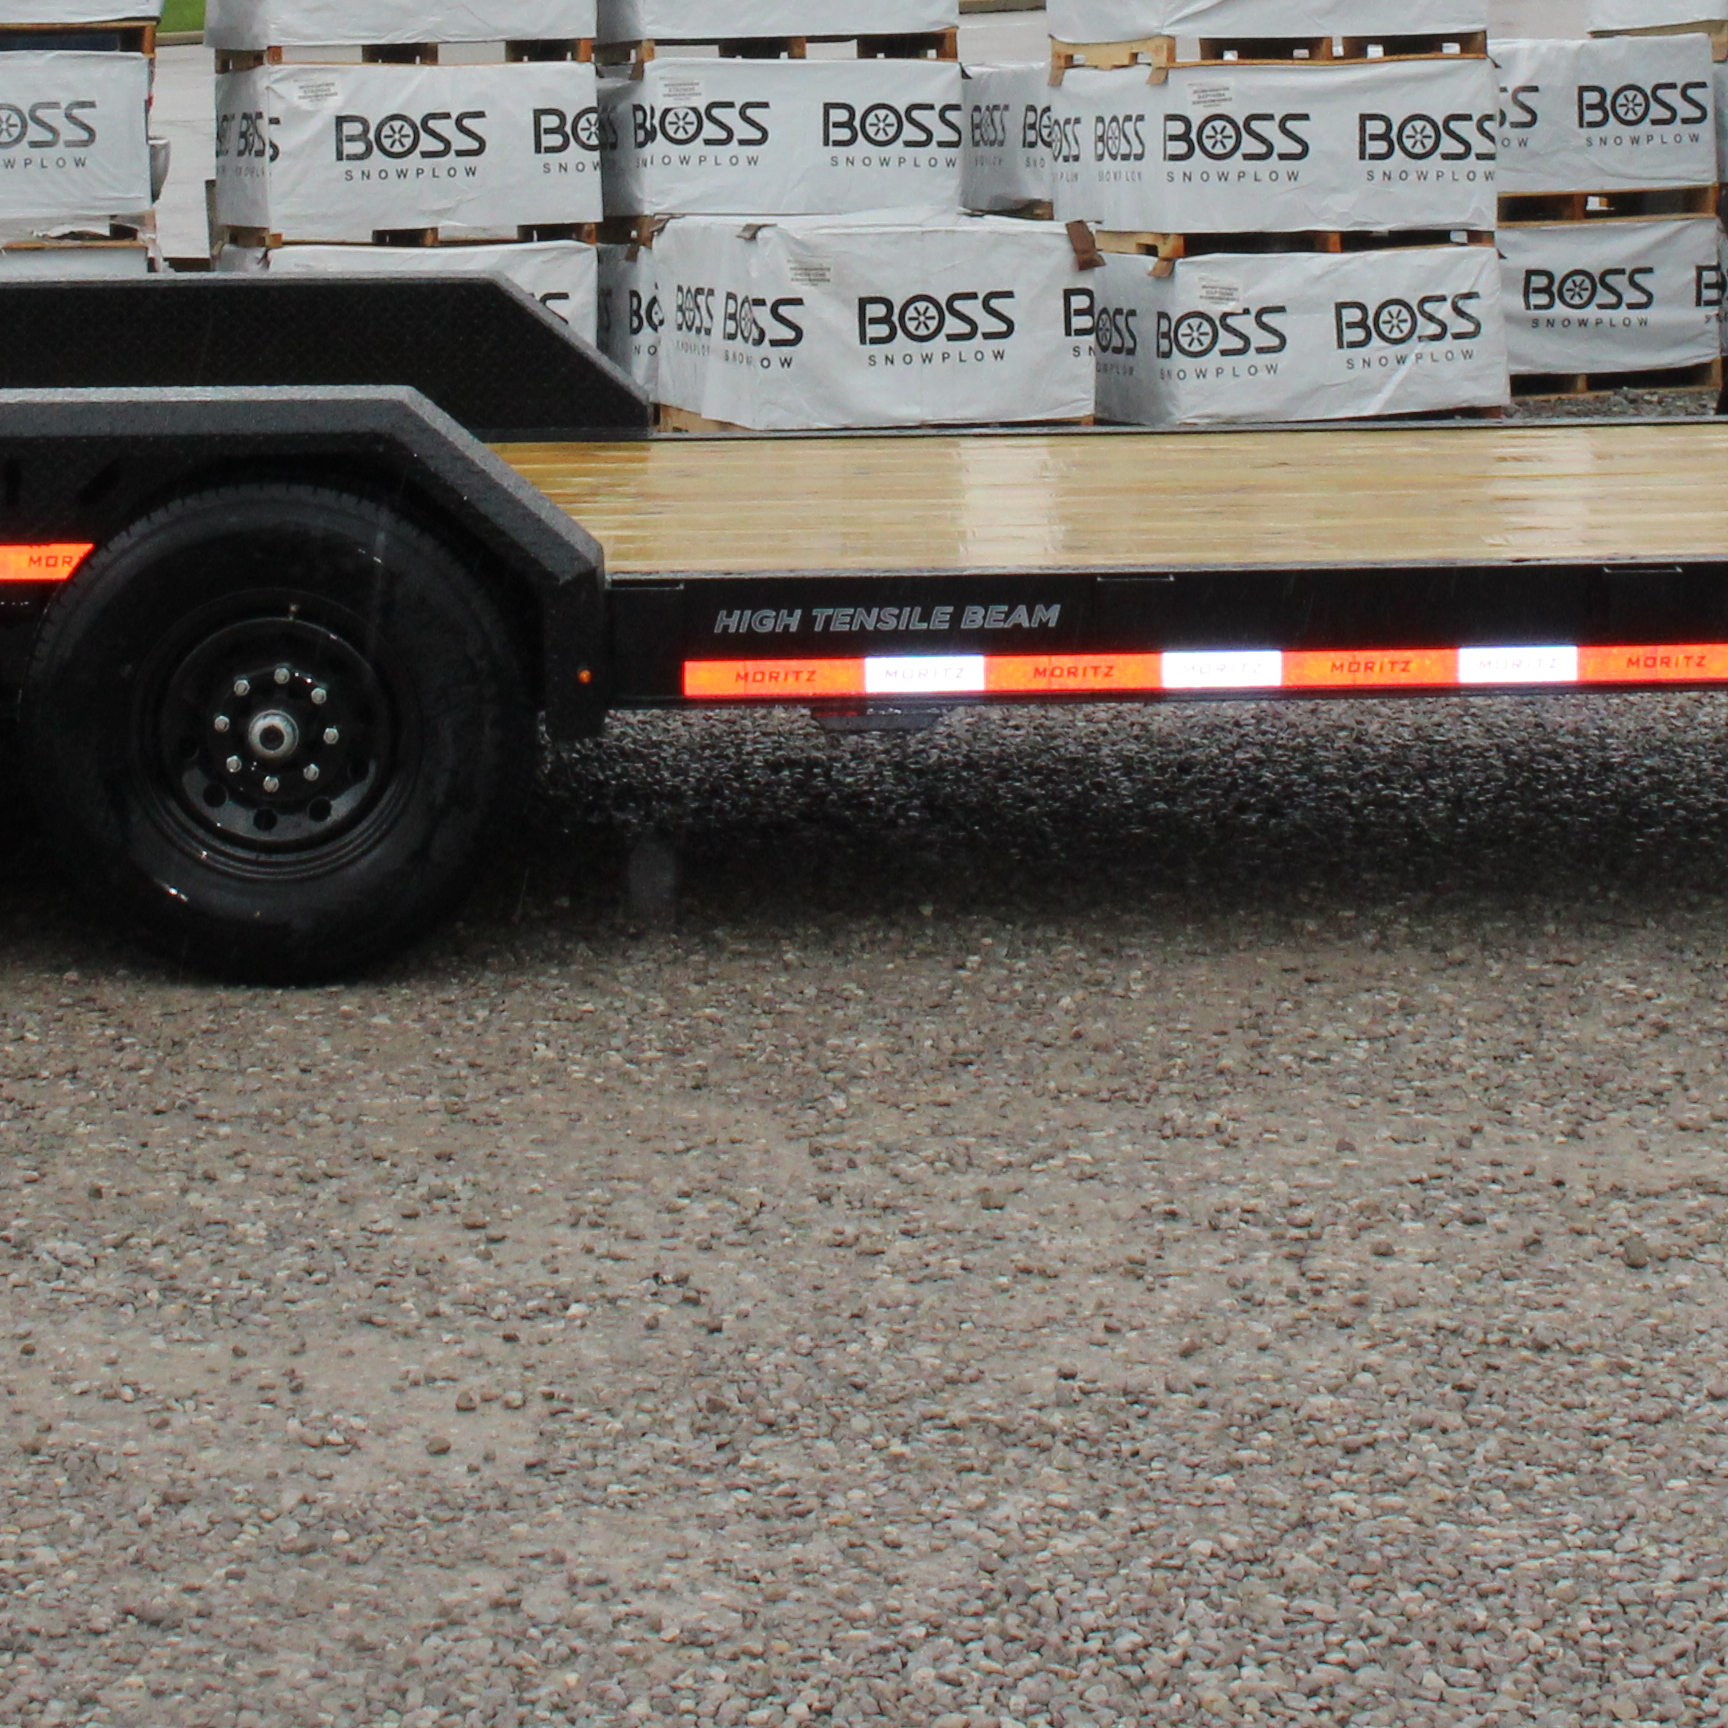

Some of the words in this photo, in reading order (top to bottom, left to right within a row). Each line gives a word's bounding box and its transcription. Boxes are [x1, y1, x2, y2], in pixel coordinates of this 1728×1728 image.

[1578, 82, 1708, 128] BOSS
[335, 111, 486, 161] BOSS
[534, 108, 600, 154] BO
[823, 103, 962, 148] BOSS
[1023, 105, 1052, 148] BO
[1052, 118, 1081, 162] OSS
[1095, 114, 1145, 161] BOSS
[1164, 114, 1311, 161] BOSS
[1359, 114, 1497, 161] BOSS
[1586, 134, 1700, 147] SNOWPLOW
[345, 166, 477, 181] SNOWPLOW
[831, 156, 957, 167] SNOWPLOW
[1167, 170, 1300, 182] SNOWPLOW
[1367, 170, 1495, 181] SNOWPLOW
[1523, 267, 1653, 310] BOSS
[858, 291, 1014, 345] BOSS
[1096, 307, 1137, 355] OSS
[1156, 306, 1286, 358] BOSS
[1334, 292, 1482, 350] BOSS
[1532, 316, 1648, 328] SNOWPLOW
[868, 350, 1005, 366] SNOWPLOW
[1346, 348, 1474, 370] SNOWPLOW
[28, 555, 75, 568] MOR
[714, 610, 801, 633] HIGH
[812, 606, 953, 632] TENSILE
[961, 604, 1060, 628] BEAM
[735, 670, 816, 683] MORITZ
[1033, 666, 1114, 679] MORITZ
[1331, 660, 1412, 673] MORITZ
[1627, 656, 1707, 668] MORITZ
